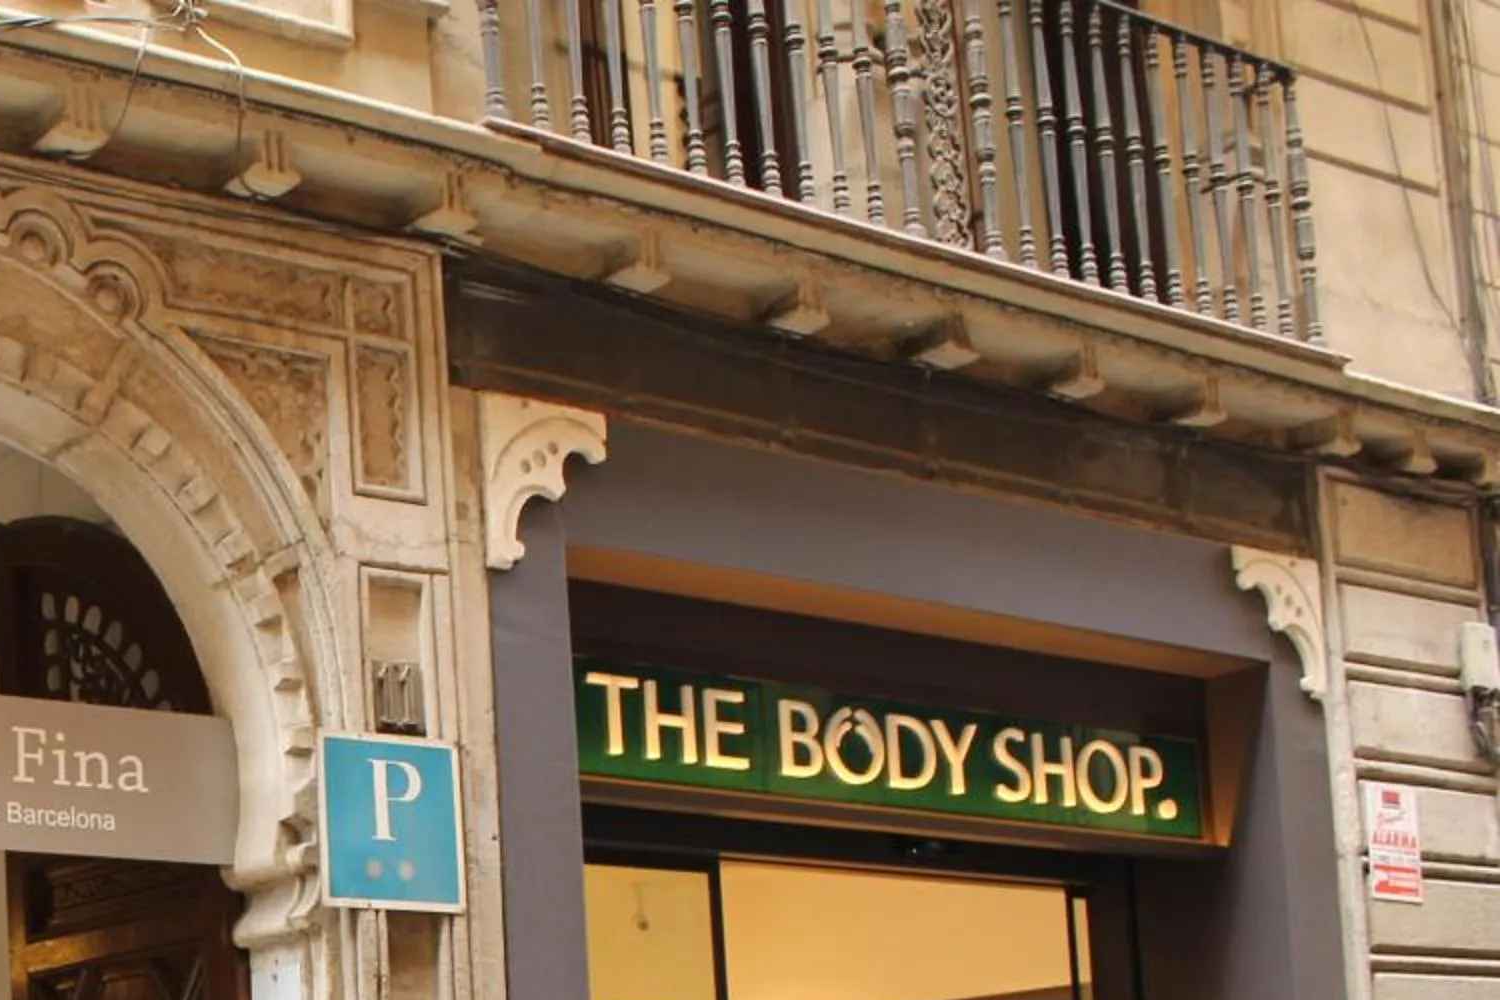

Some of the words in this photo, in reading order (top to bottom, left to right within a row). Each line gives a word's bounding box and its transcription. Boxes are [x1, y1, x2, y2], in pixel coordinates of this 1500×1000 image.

[11, 726, 150, 793] Fina
[586, 671, 750, 771] THE
[778, 698, 978, 795] BODY
[6, 805, 117, 831] Barcelona
[366, 758, 423, 841] P
